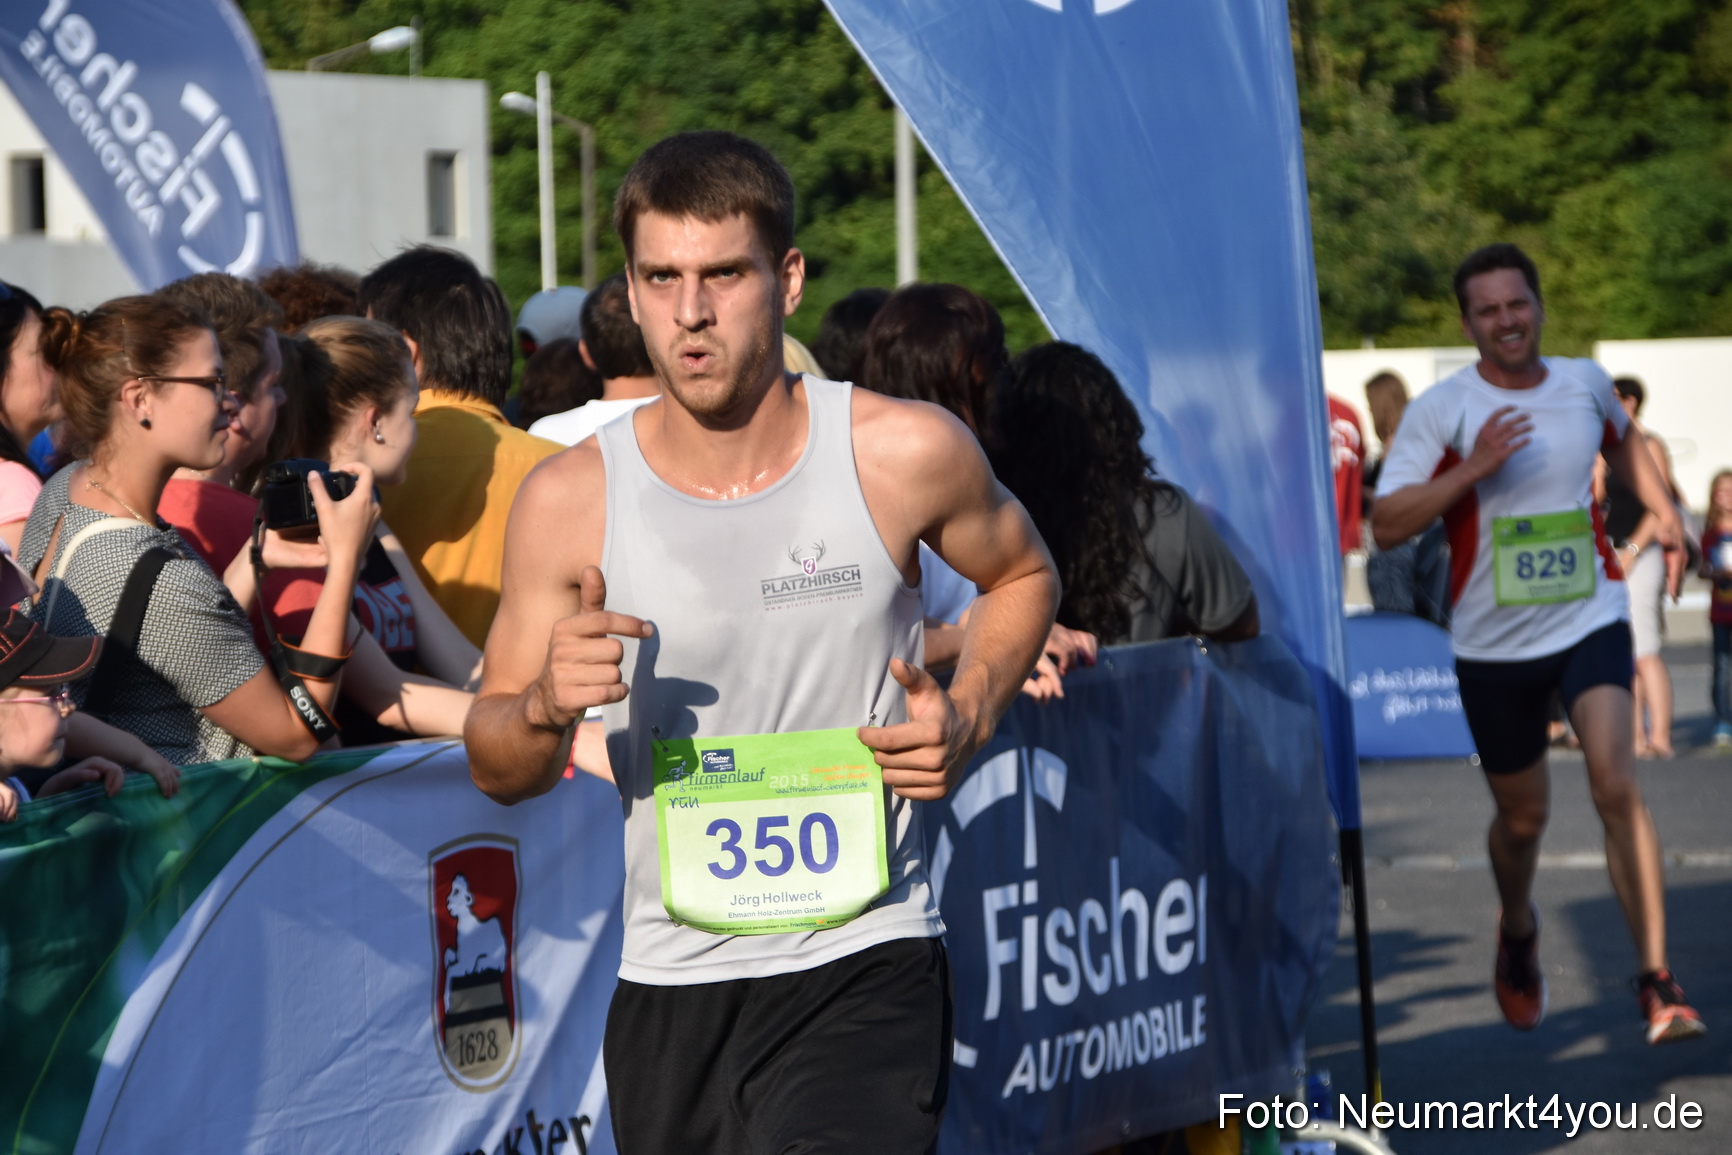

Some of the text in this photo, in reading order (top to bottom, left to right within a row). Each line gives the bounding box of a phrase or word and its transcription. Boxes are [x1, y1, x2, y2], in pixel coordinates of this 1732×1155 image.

[1516, 547, 1577, 580] 829
[761, 569, 861, 595] PLATZHIRSCH
[289, 685, 327, 731] SONY
[689, 767, 766, 786] firmenlauf
[769, 774, 809, 789] 2015
[705, 812, 840, 880] 350
[730, 890, 823, 907] Jörg Hollweck
[728, 911, 756, 919] Ehmann
[757, 909, 803, 917] Holz-Zentrum
[456, 1029, 499, 1067] 1628
[1002, 995, 1207, 1100] AUTOMOBILE
